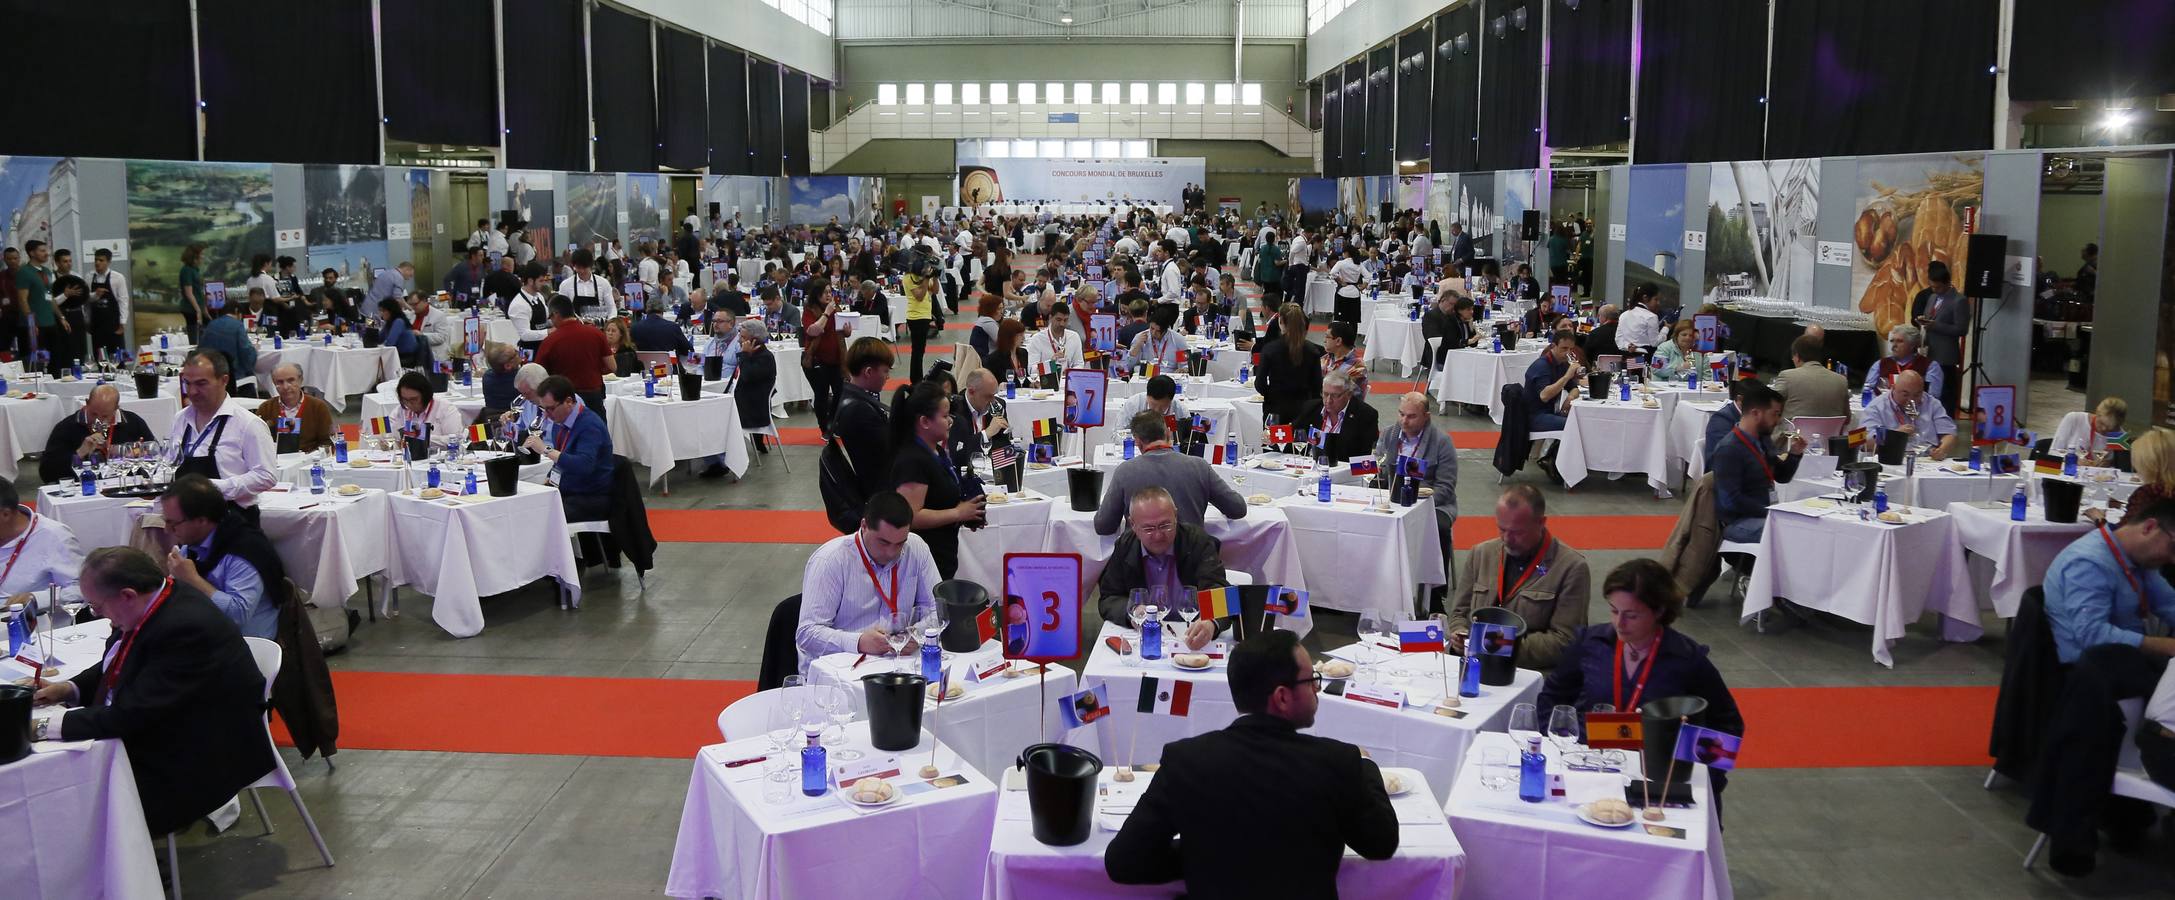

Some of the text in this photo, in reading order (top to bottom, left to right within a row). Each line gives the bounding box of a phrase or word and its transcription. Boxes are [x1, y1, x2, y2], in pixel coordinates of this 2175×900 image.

[718, 270, 728, 279] 18
[213, 291, 224, 302] 13
[631, 291, 642, 303] 14
[1557, 295, 1568, 306] 16
[470, 330, 478, 345] 10
[1100, 326, 1112, 342] 11
[1702, 327, 1714, 342] 12
[1084, 389, 1096, 411] 7
[1993, 404, 2005, 427] 8
[1041, 590, 1062, 633] 3
